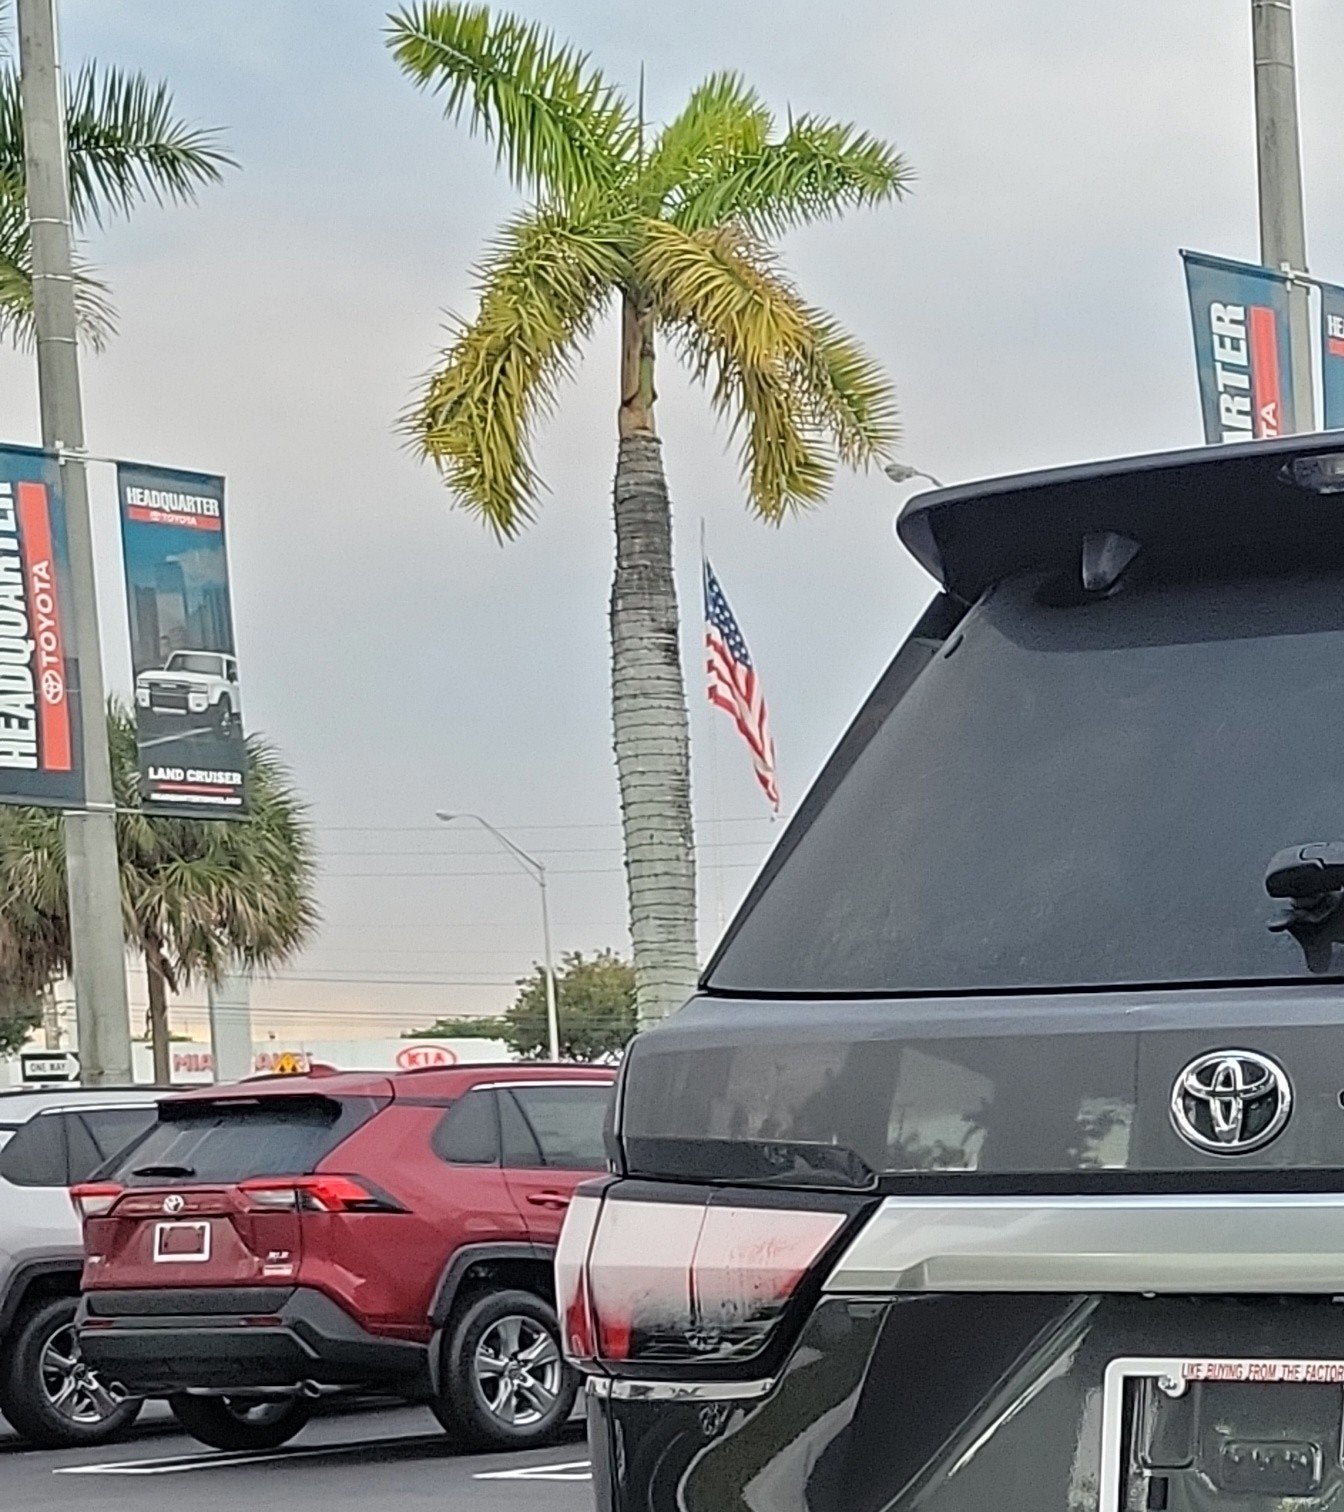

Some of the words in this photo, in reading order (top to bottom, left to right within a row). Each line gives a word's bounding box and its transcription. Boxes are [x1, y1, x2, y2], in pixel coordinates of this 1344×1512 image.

[126, 485, 220, 517] HEADQUARTER
[32, 560, 58, 667] TOYOTA
[148, 765, 184, 781] LAND
[186, 768, 243, 785] CRUISER
[29, 1062, 47, 1073] ONE
[407, 1052, 445, 1067] KIA
[1181, 1362, 1203, 1379] LIKE
[1206, 1363, 1244, 1380] BUYING
[1248, 1363, 1278, 1381] FROM
[1281, 1364, 1301, 1380] THE
